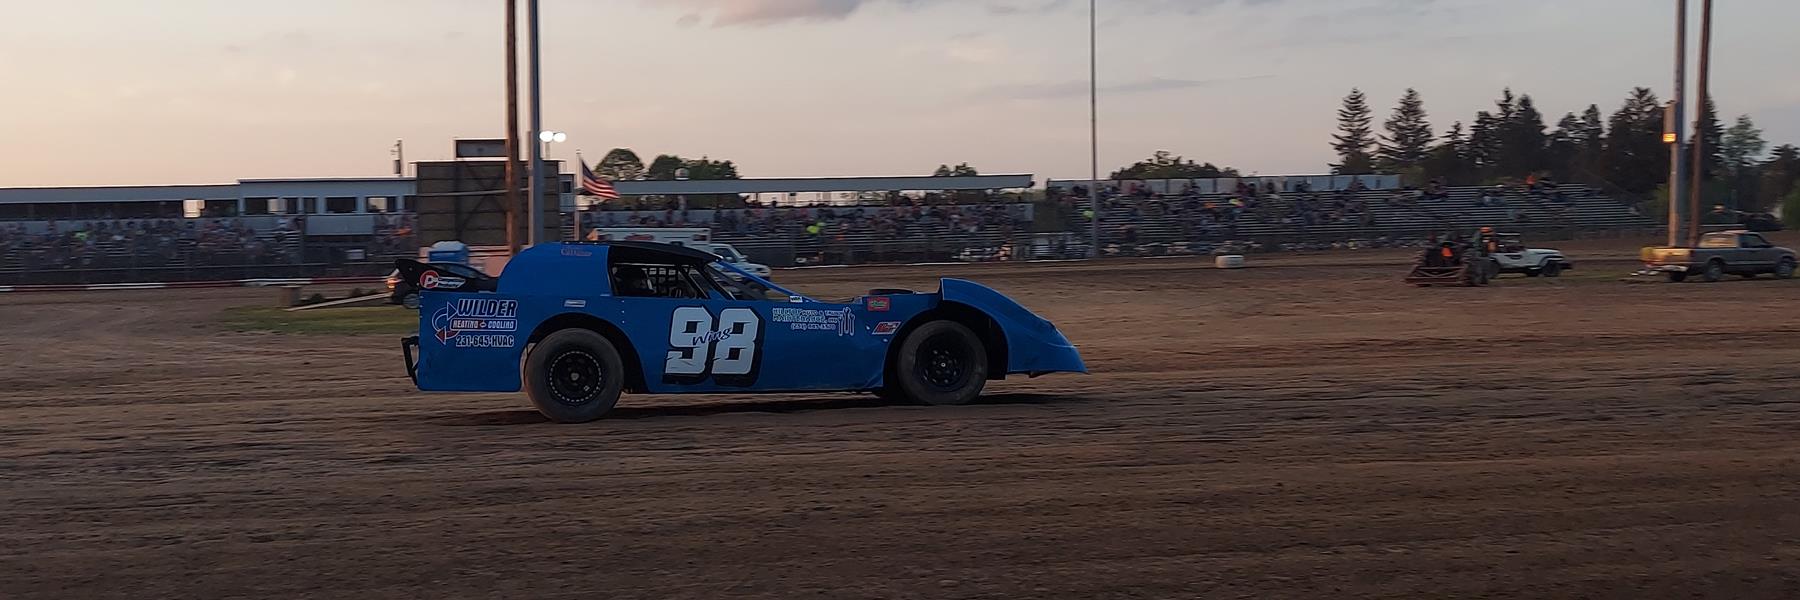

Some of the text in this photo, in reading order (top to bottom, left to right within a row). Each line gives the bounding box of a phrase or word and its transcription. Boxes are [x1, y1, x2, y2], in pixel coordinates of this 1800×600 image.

[457, 299, 518, 317] WILDER
[452, 320, 514, 329] HEATING COOLING
[456, 334, 514, 347] 231-645-HVAC
[664, 305, 764, 385] 98
